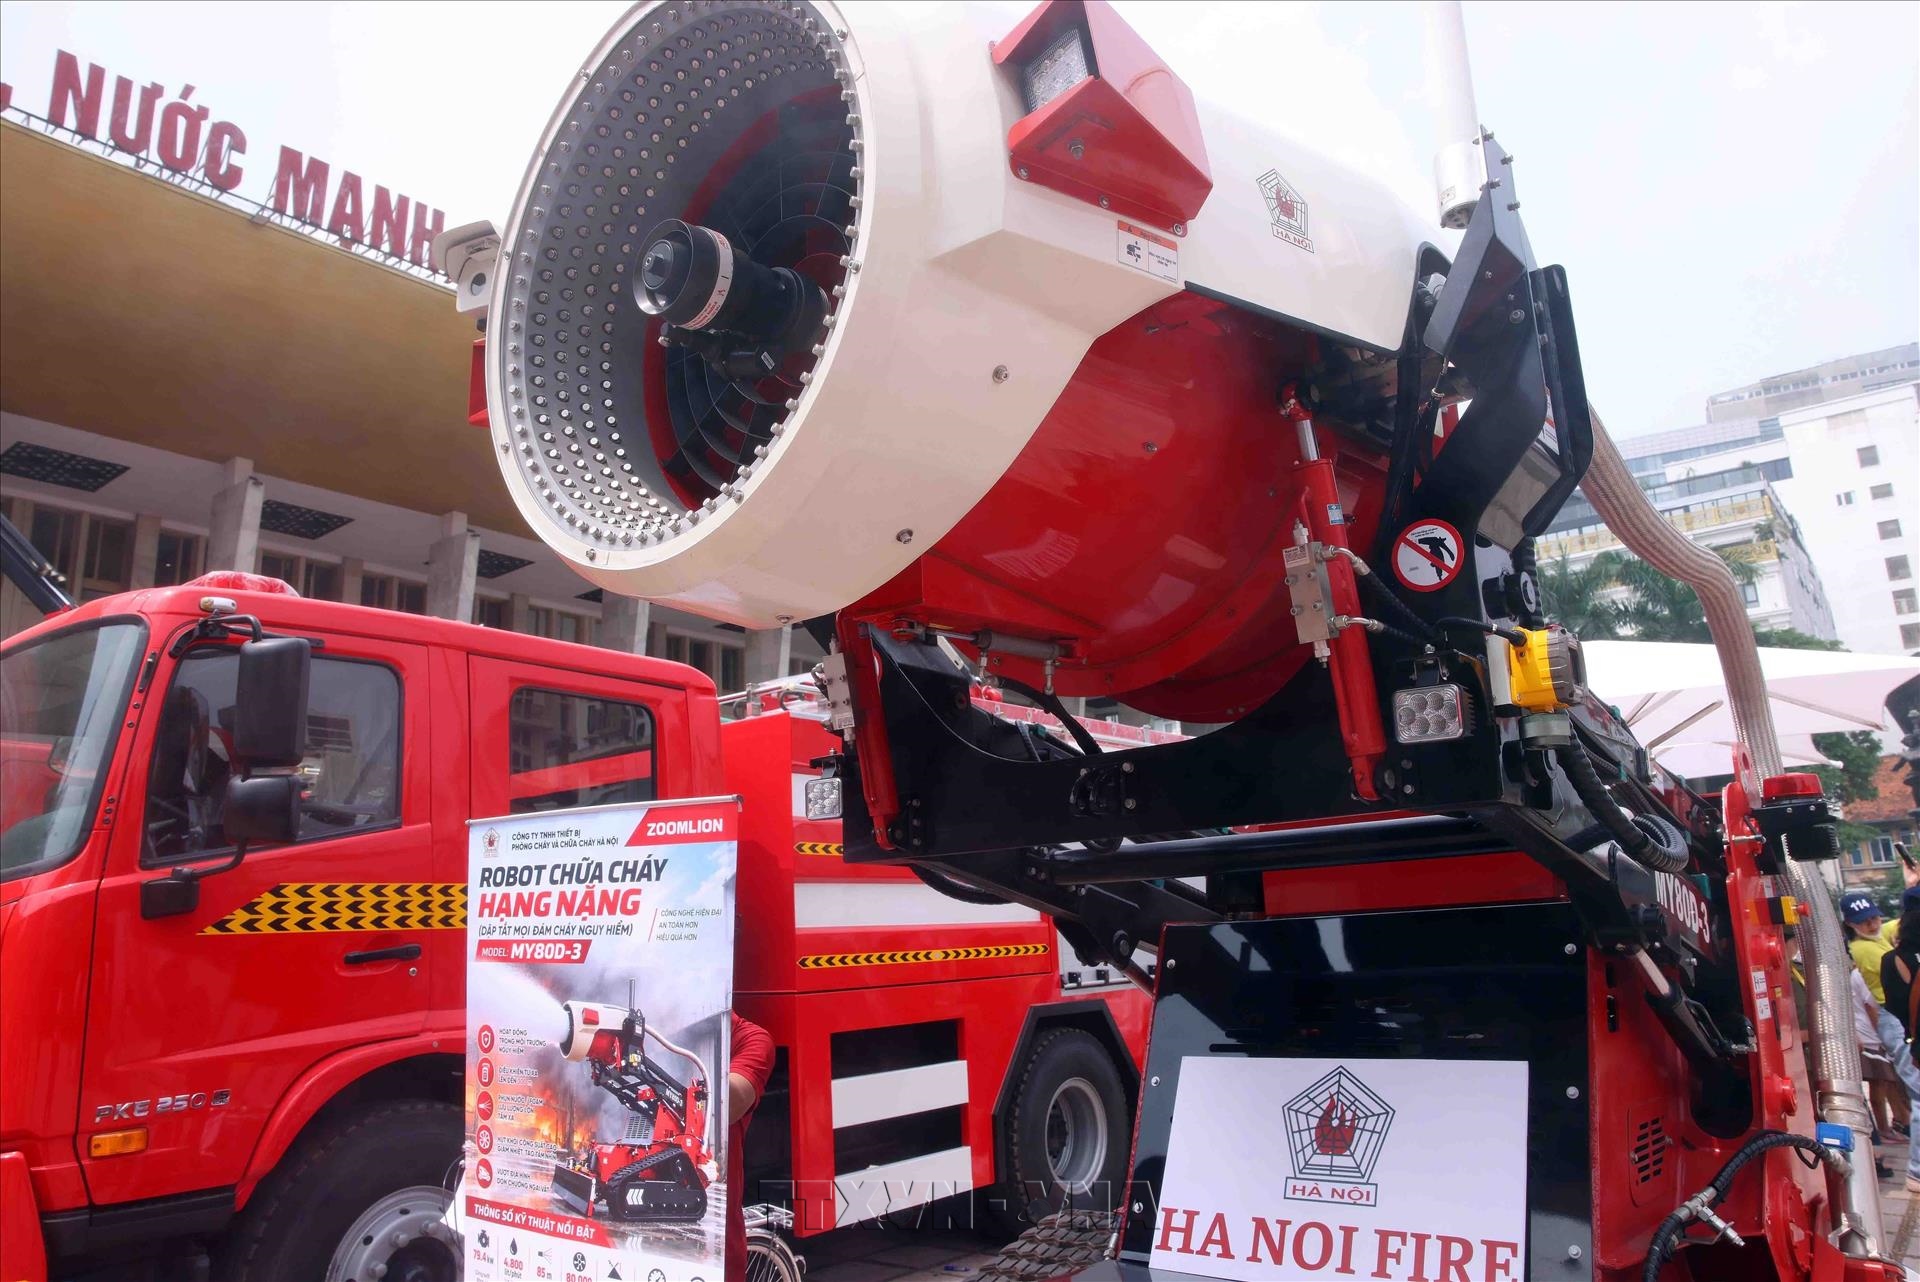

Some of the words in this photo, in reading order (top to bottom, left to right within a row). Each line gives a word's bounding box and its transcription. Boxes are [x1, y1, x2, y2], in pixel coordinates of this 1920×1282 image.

[48, 48, 248, 192] NƯỚC
[273, 144, 446, 273] MẠNH
[511, 831, 530, 842] CÔNG
[531, 832, 539, 840] TY
[540, 831, 556, 840] TNHH
[556, 828, 573, 839] THIẾT
[574, 829, 581, 839] BỊ
[646, 818, 724, 837] ZOOMLION
[511, 841, 533, 851] PHÒNG
[533, 840, 550, 850] CHÁY
[551, 840, 559, 849] VÀ
[559, 838, 577, 849] CHỮA
[578, 838, 596, 847] CHÁY
[596, 837, 605, 846] HÀ
[606, 836, 619, 846] NỘI
[479, 864, 547, 888] ROBOT
[549, 857, 604, 885] CHỮA
[608, 854, 669, 883] CHÁY
[478, 891, 552, 921] HẠNG
[555, 884, 642, 921] NẶNG
[1654, 870, 1710, 944] MY80D-3
[1850, 898, 1870, 912] 114
[660, 908, 677, 917] CÔNG
[478, 924, 497, 939] (DẬP
[498, 923, 513, 937] TẮT
[513, 925, 530, 938] MỌI
[532, 923, 552, 936] ĐÁM
[553, 922, 577, 936] CHÁY
[578, 924, 605, 936] NGUY
[606, 920, 633, 937] HIỂM)
[510, 942, 582, 961] MY80D-3
[94, 1100, 150, 1123] PKE
[156, 1092, 207, 1113] 250
[1291, 1182, 1323, 1198] HÀ
[1330, 1186, 1371, 1204] NỘI
[474, 1204, 501, 1220] THÔNG
[501, 1208, 514, 1222] SỐ
[514, 1212, 527, 1225] KỸ
[527, 1215, 556, 1233] THUẬT
[575, 1223, 596, 1241] BẬT
[1154, 1206, 1235, 1260] HA
[1246, 1216, 1359, 1276] NOI
[1371, 1228, 1519, 1282] FIRE
[473, 1249, 486, 1261] 79.4
[503, 1257, 523, 1271] 4.800
[536, 1266, 546, 1278] 85
